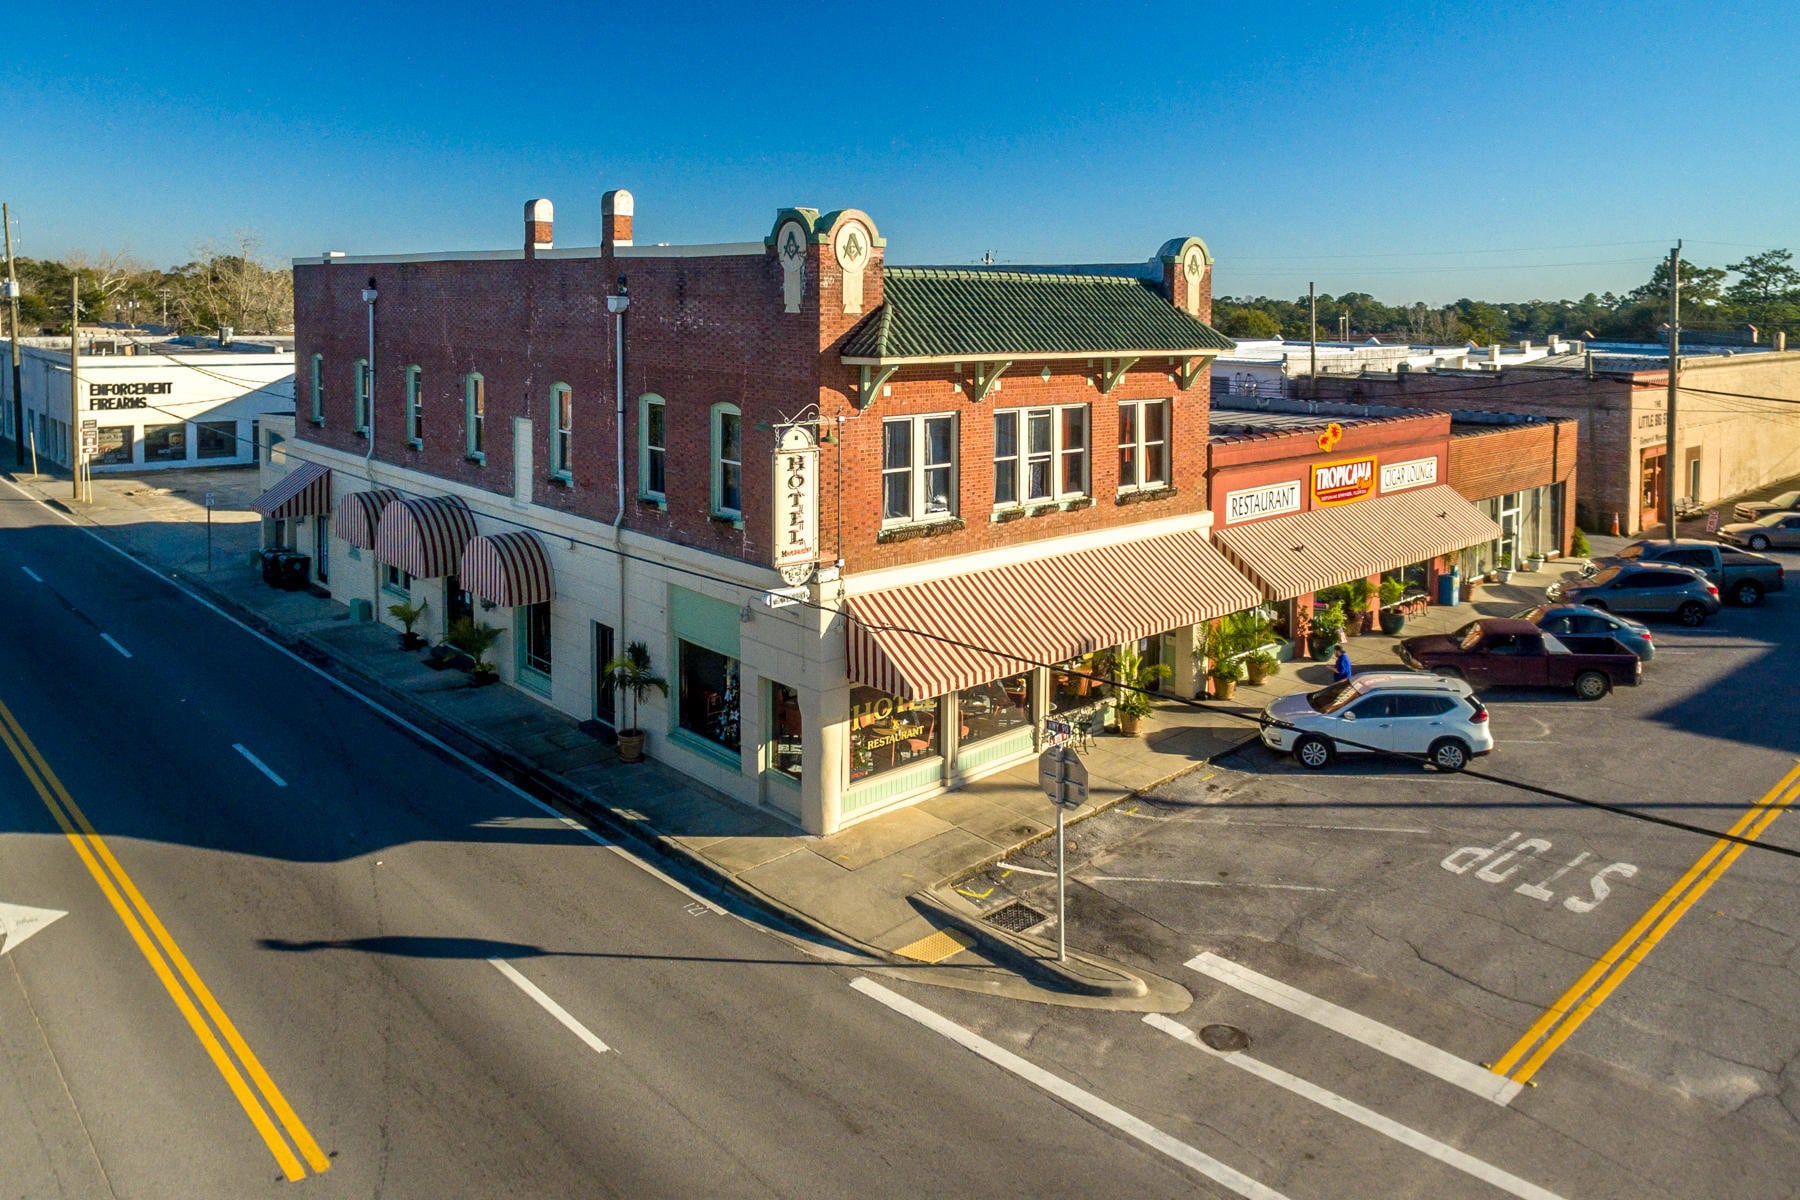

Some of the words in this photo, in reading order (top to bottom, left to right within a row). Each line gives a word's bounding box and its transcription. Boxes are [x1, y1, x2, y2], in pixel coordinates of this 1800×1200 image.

[89, 382, 173, 396] ENFORCEMENT
[89, 397, 147, 411] FIREARMS
[1638, 414, 1654, 429] LITTLE
[1316, 461, 1372, 490] TROPICANA
[1384, 466, 1405, 487] CIGAR
[786, 455, 806, 546] HOTEL
[1232, 486, 1296, 518] RESTAURANT
[892, 719, 901, 730] &
[867, 726, 924, 750] RESTAURANT
[1439, 831, 1639, 914] STOP
